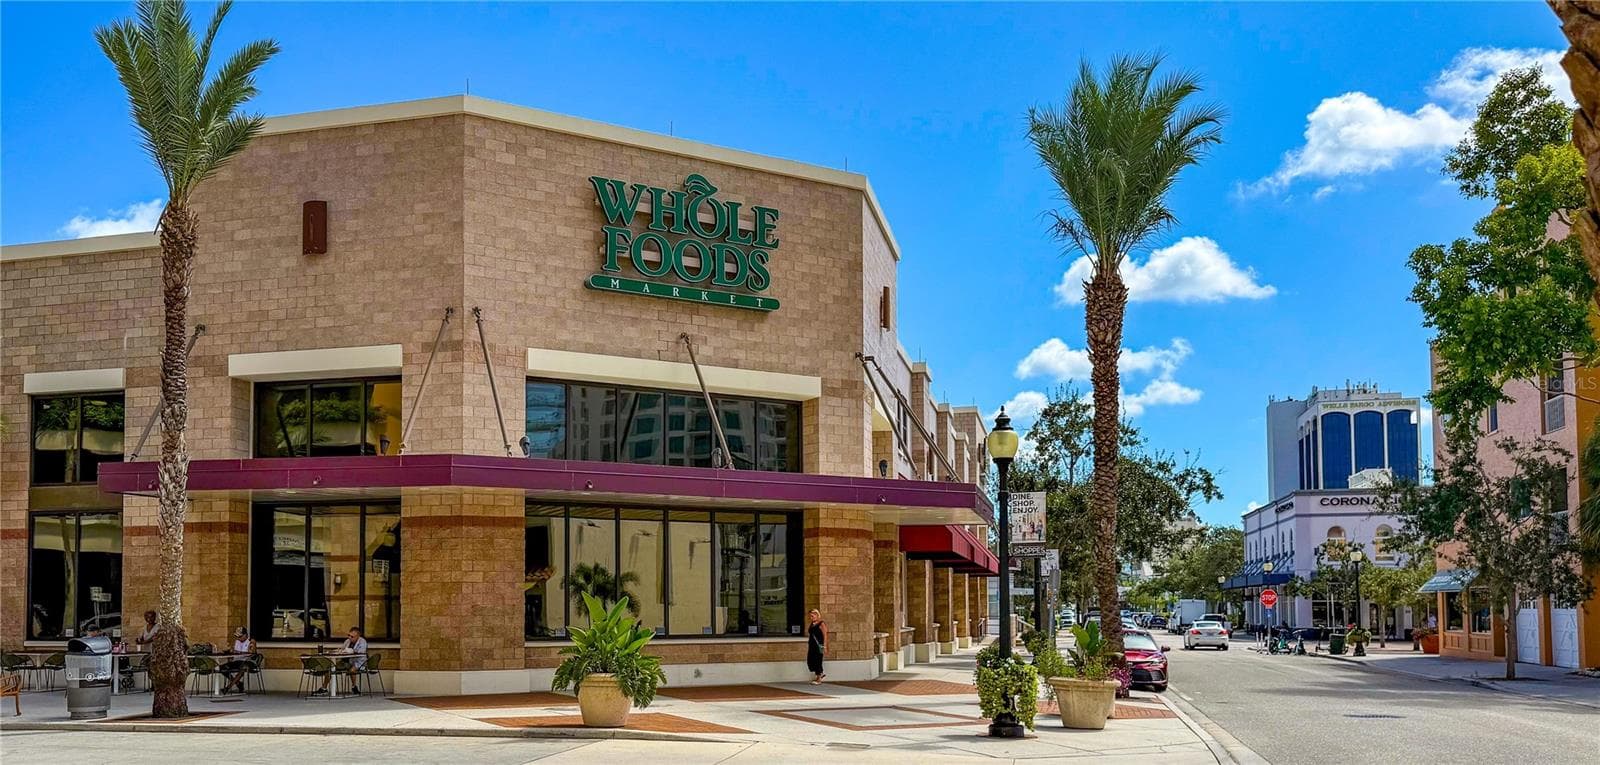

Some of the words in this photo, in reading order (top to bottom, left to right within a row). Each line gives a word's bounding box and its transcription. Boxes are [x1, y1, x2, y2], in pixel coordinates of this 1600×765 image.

[589, 174, 779, 249] WHOLE
[601, 226, 772, 292] FOODS
[611, 279, 764, 307] MARKET
